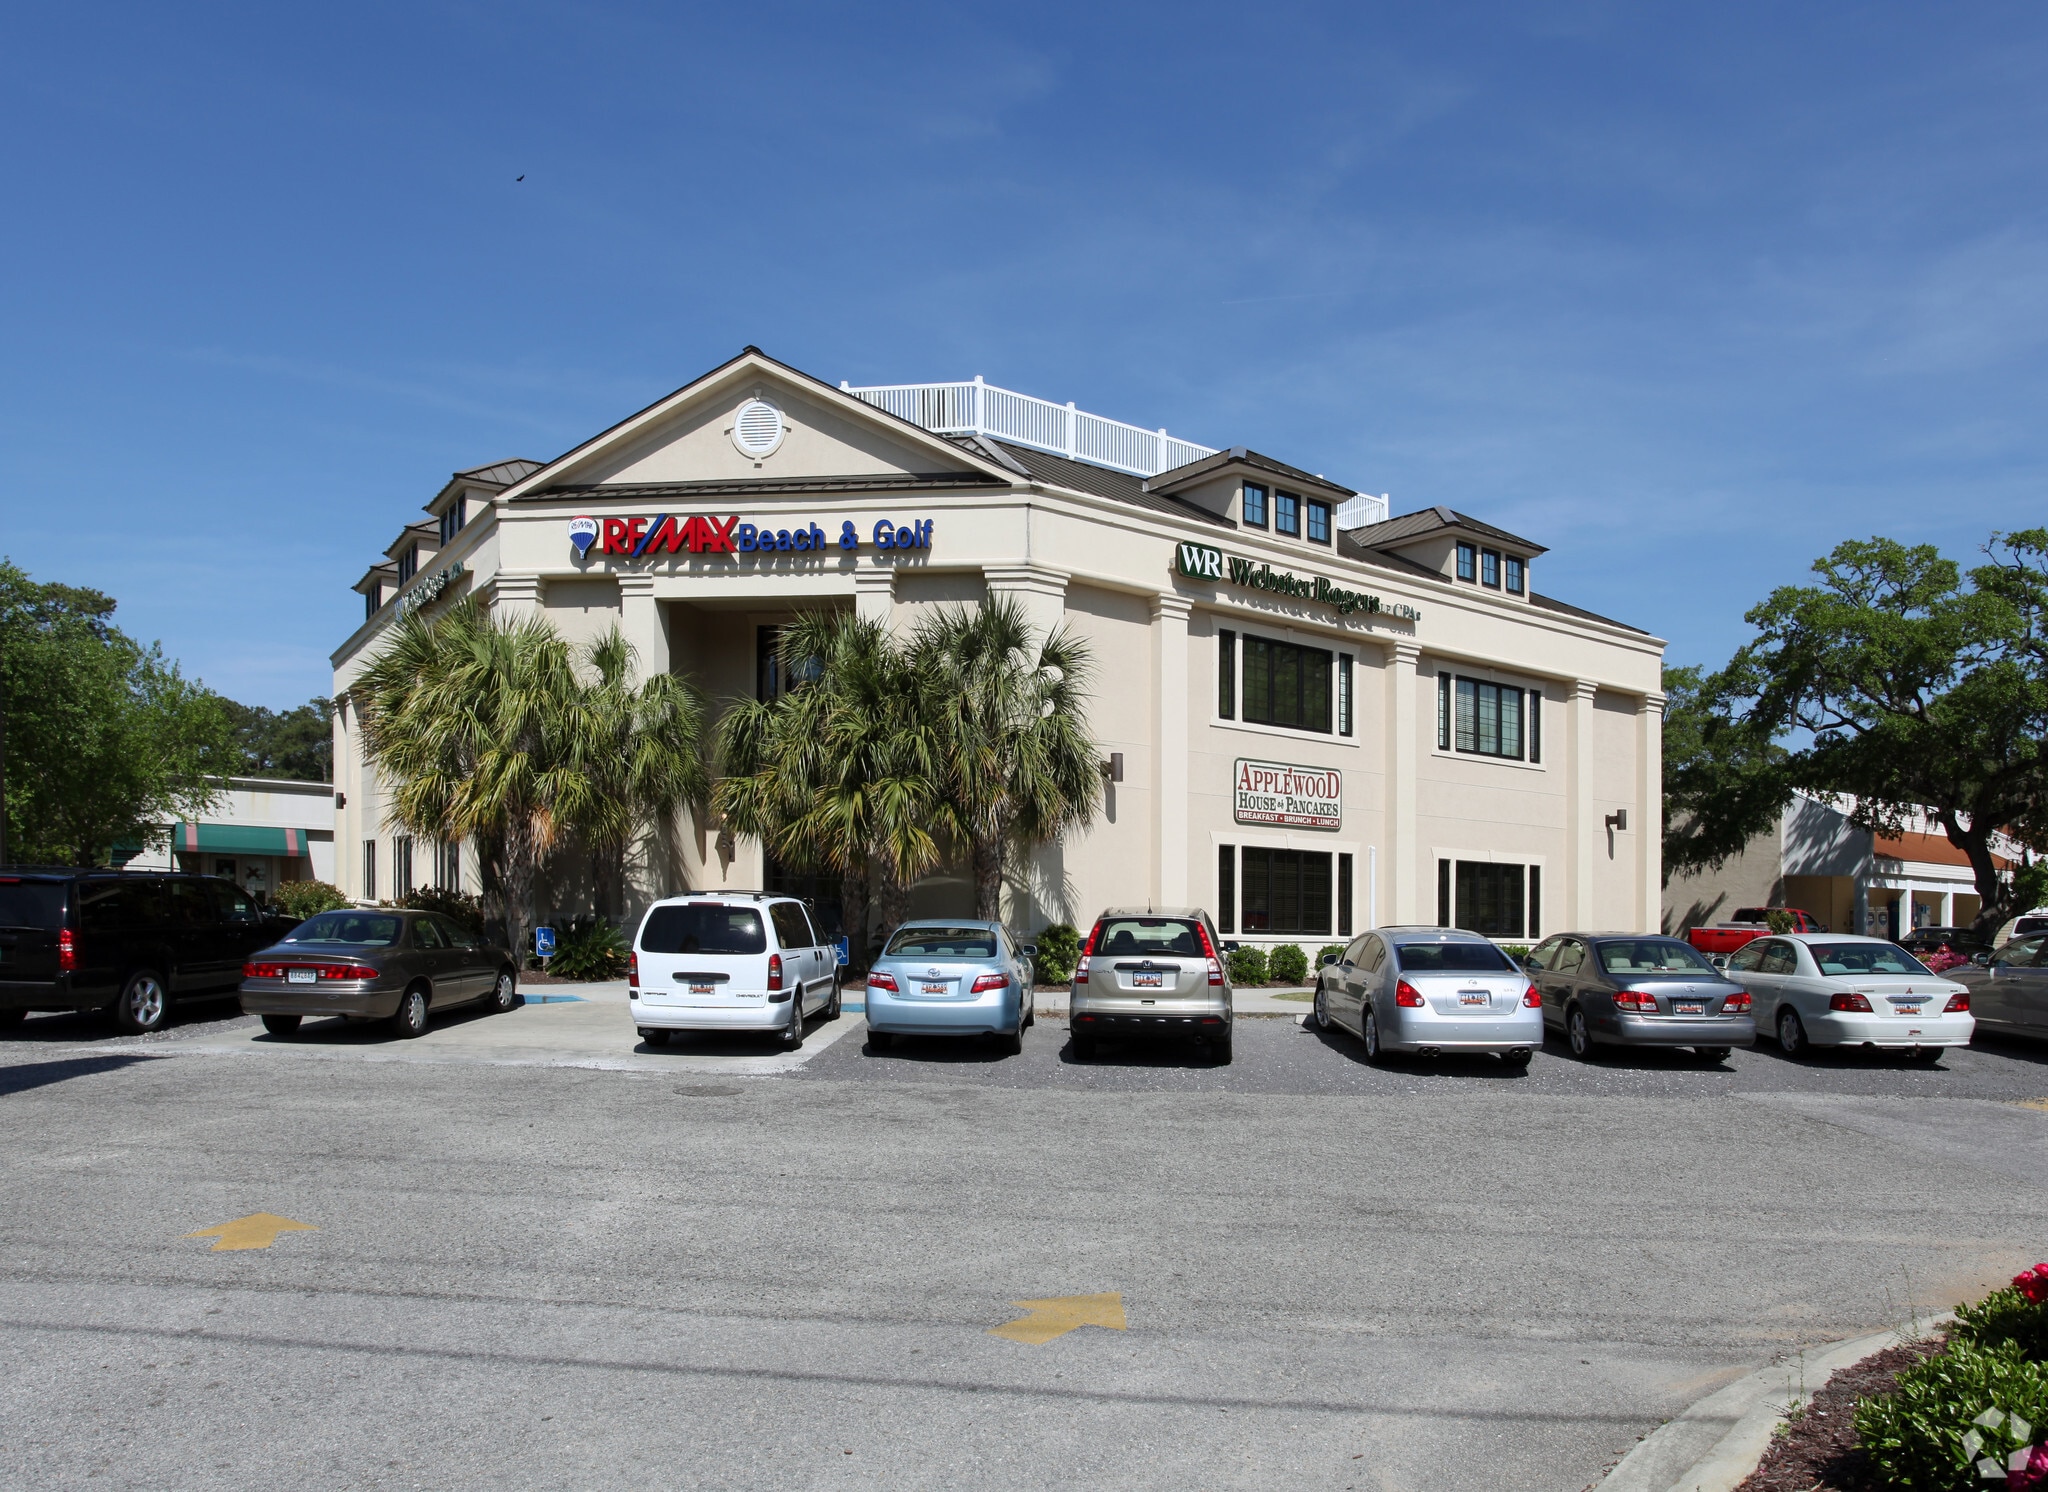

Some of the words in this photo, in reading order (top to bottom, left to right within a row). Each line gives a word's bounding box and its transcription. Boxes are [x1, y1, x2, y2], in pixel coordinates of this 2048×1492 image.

[602, 513, 741, 559] RE/MAX
[738, 521, 826, 552] Beach
[838, 519, 859, 551] &
[872, 518, 935, 550] Golf
[1180, 544, 1222, 578] WR
[1393, 603, 1421, 622] CPAs
[1237, 762, 1340, 799] APPLEWOOD
[1238, 791, 1277, 812] HOUSE
[1277, 799, 1284, 810] of
[1285, 796, 1339, 817] PANCAKES
[1238, 811, 1279, 822] BREAKFAST
[1284, 815, 1312, 824] BRUNCH
[1316, 818, 1339, 827] LUNCH
